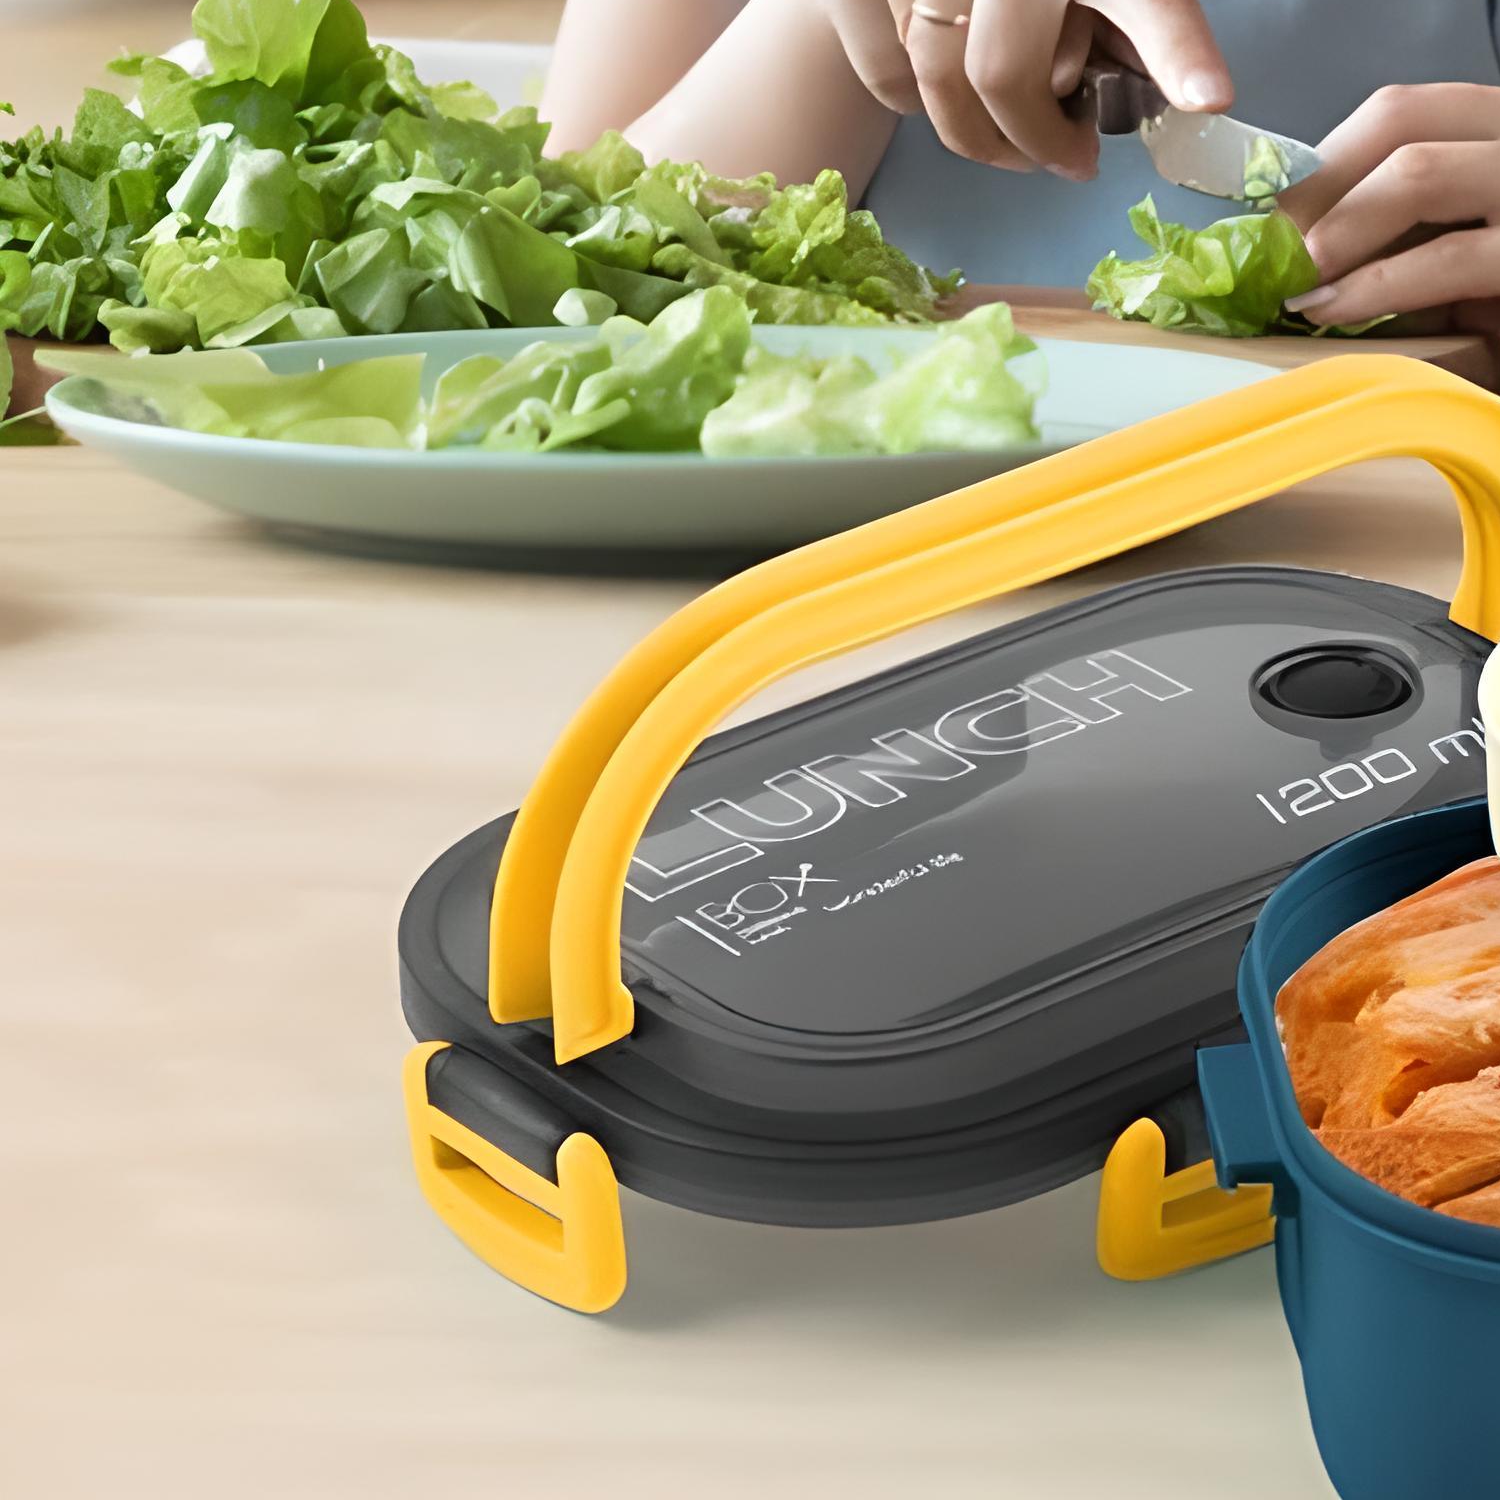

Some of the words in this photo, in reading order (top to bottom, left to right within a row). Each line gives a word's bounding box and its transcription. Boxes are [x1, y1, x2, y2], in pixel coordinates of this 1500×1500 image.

[624, 649, 1193, 902] LUNCH
[1255, 747, 1418, 825] 1200
[695, 862, 840, 930] BOX
